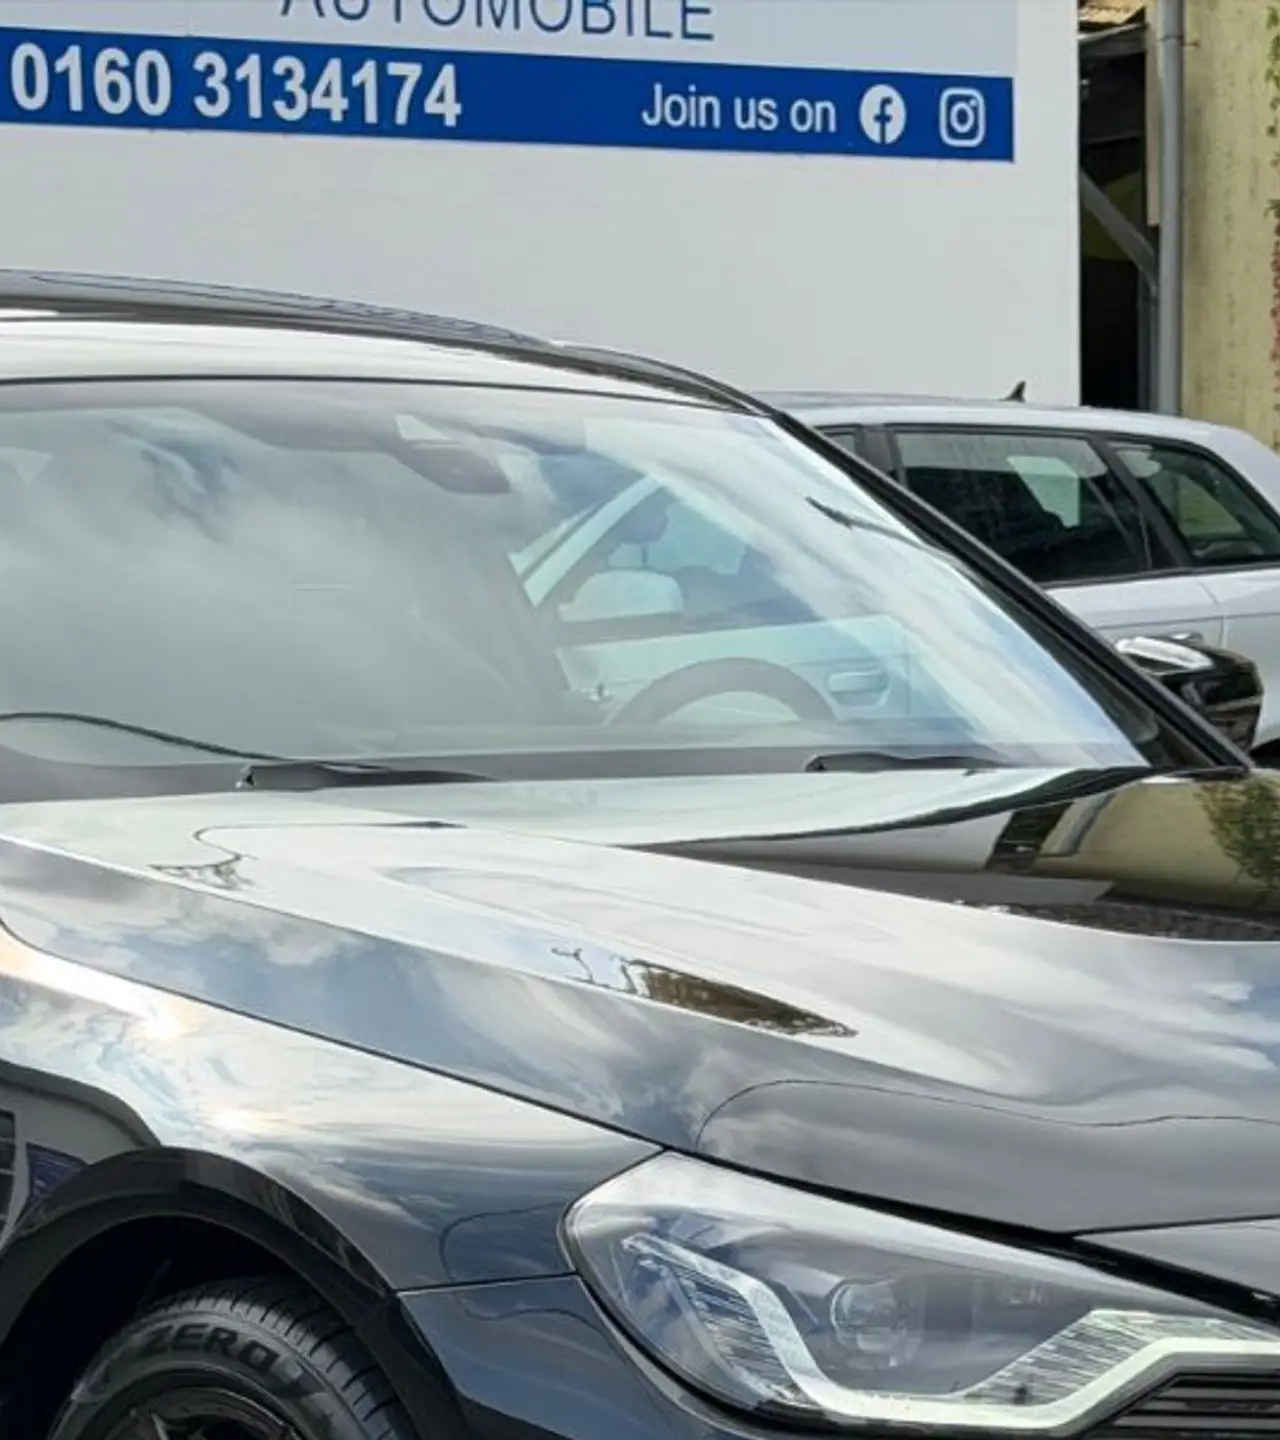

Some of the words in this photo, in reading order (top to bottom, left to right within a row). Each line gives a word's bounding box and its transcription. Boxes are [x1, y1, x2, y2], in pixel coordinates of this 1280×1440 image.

[11, 43, 172, 116] 0160
[194, 52, 462, 126] 3134174
[642, 83, 720, 127] Join
[735, 99, 779, 132] us
[791, 100, 837, 133] on
[138, 1322, 281, 1373] ZERO
